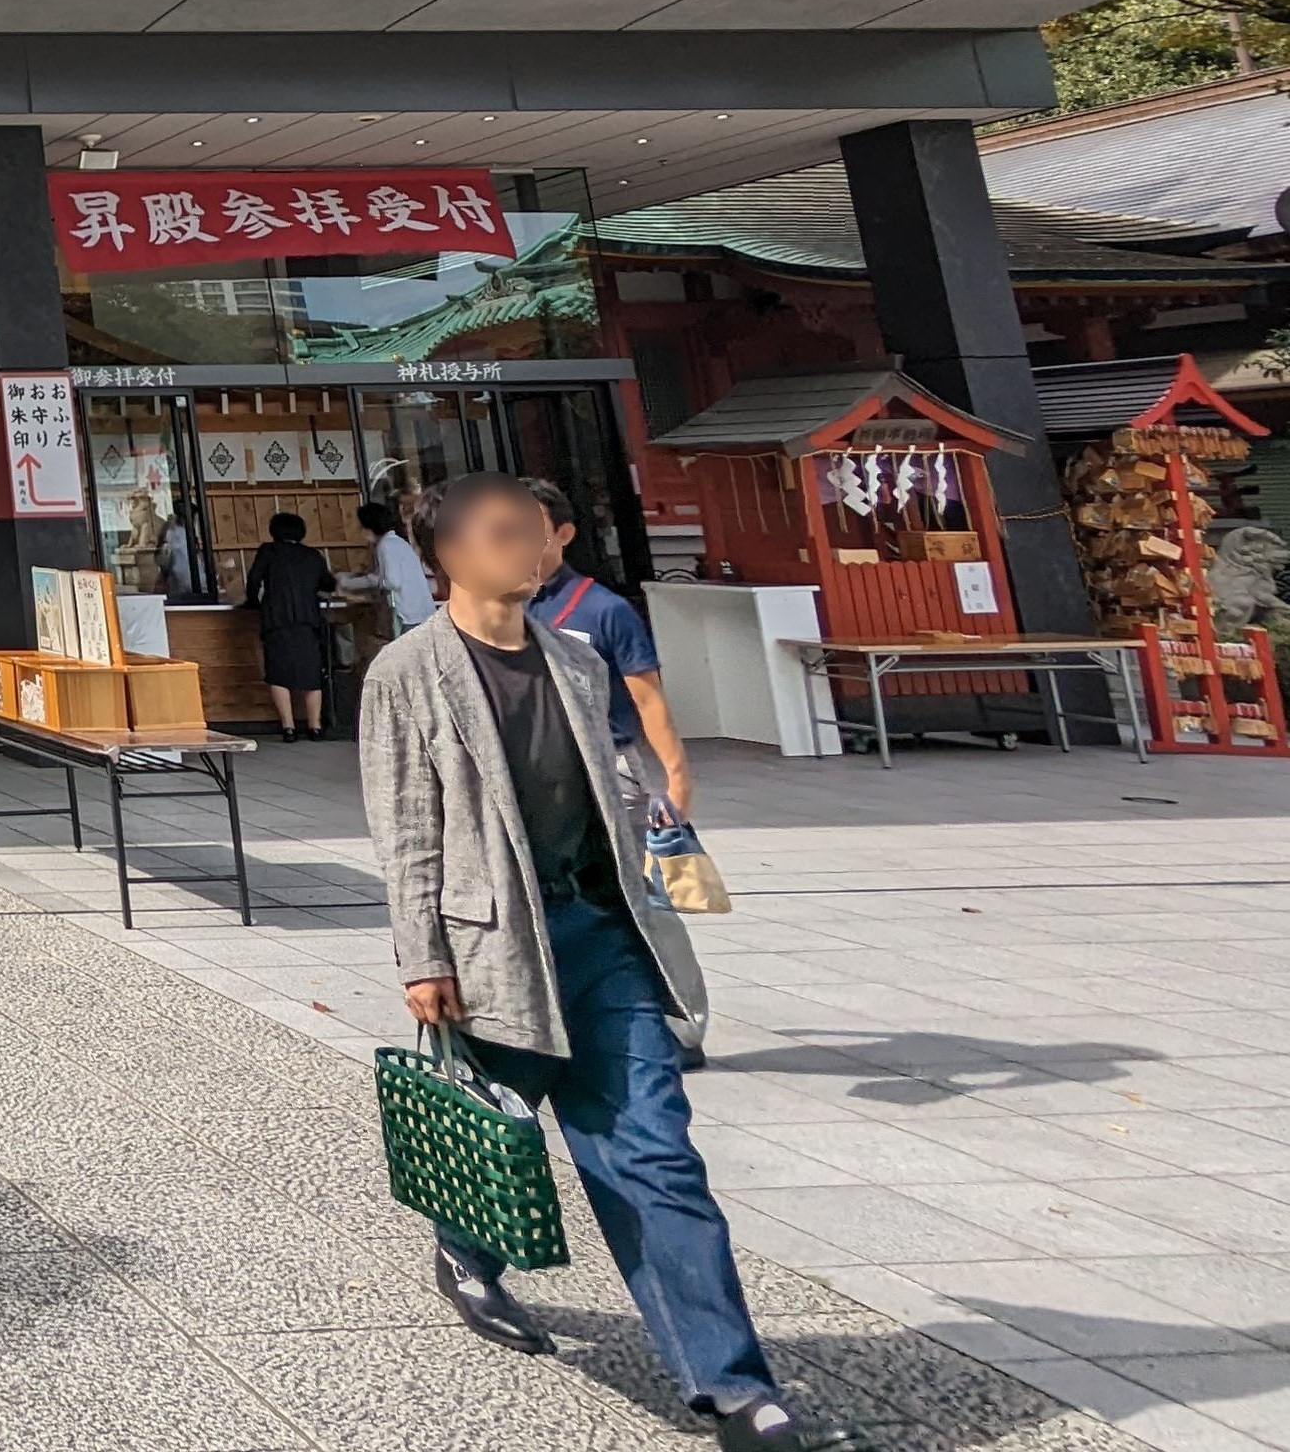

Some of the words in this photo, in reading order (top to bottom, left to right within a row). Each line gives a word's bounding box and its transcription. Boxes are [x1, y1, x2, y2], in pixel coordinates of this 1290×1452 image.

[70, 184, 498, 252] 昇殿参拝受付
[71, 366, 176, 387] 御参拝受付
[397, 362, 503, 382] 神札授与所
[8, 383, 29, 449] 御朱印
[30, 383, 48, 448] お守り
[51, 383, 73, 447] おふだ
